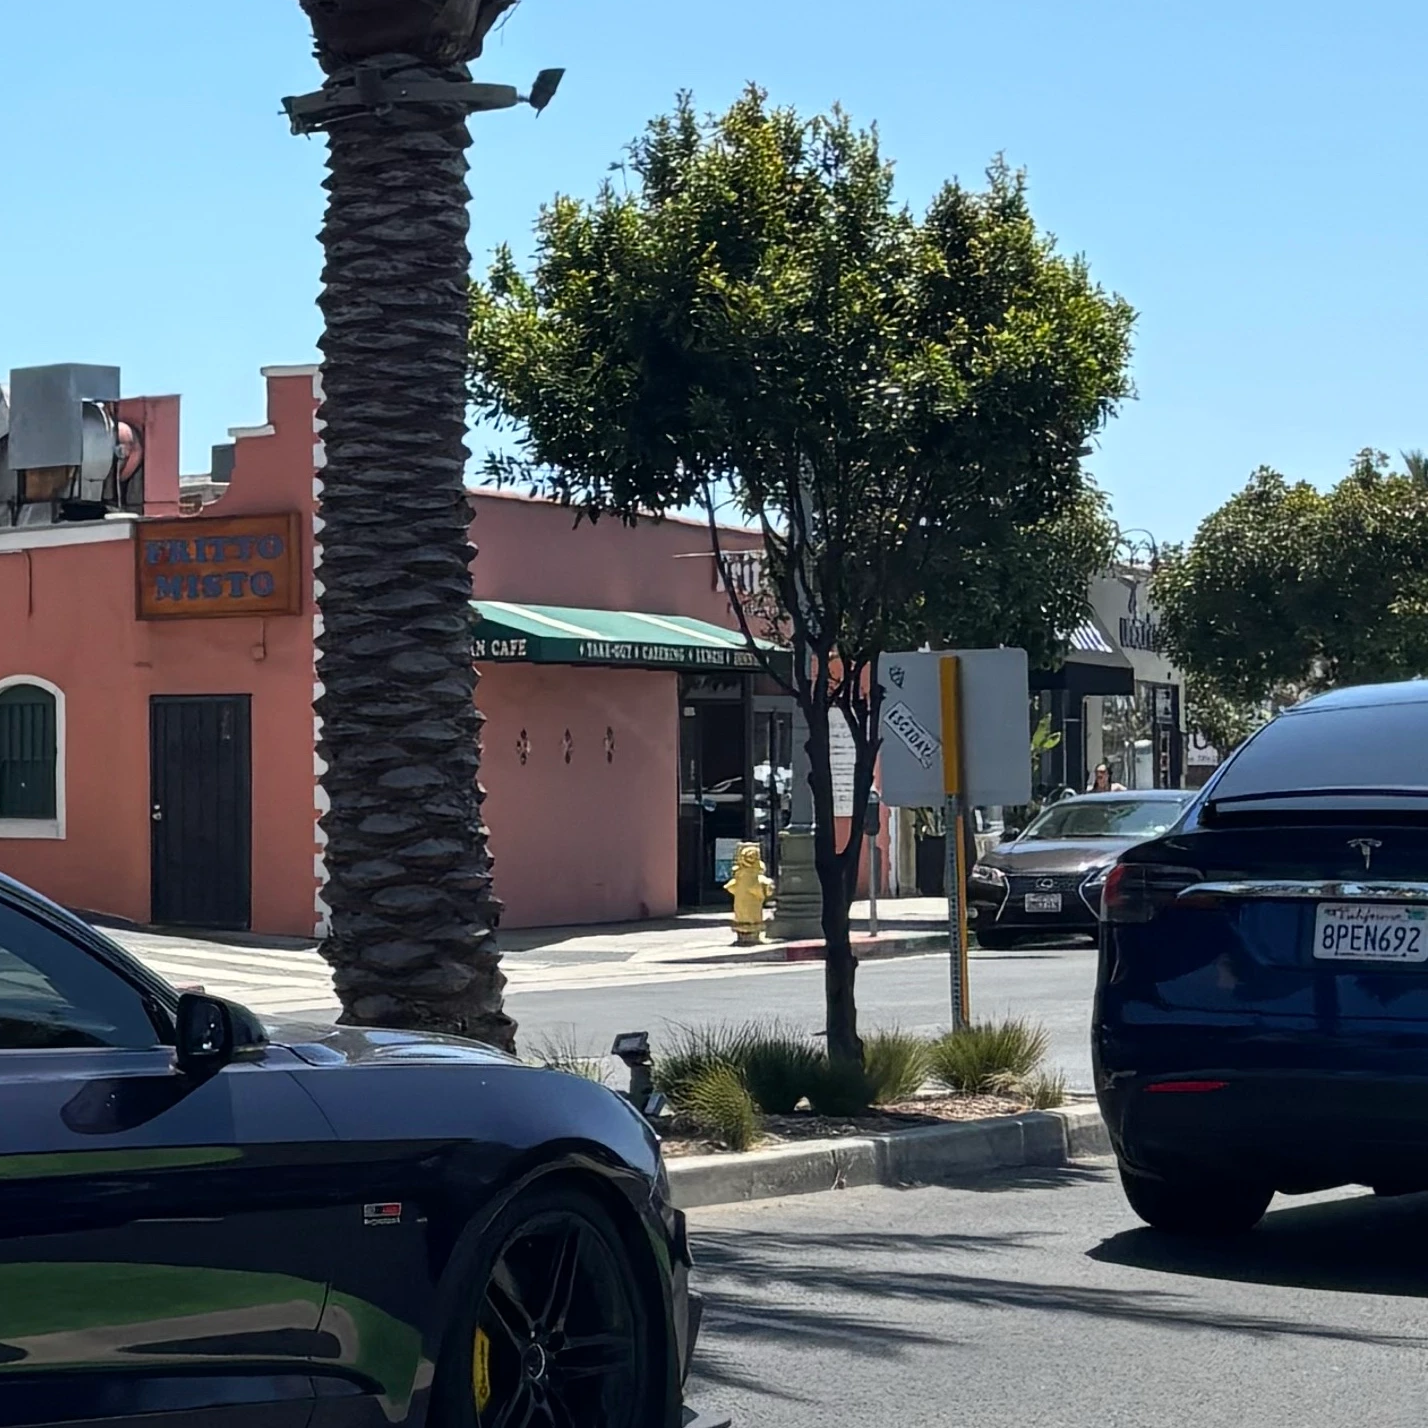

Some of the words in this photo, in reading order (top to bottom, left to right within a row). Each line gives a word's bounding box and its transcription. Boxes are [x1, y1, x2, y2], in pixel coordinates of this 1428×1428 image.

[147, 534, 284, 565] FRITTO
[155, 571, 274, 601] MISTO
[491, 638, 527, 656] CAFE
[1322, 924, 1421, 953] 8PEN692
